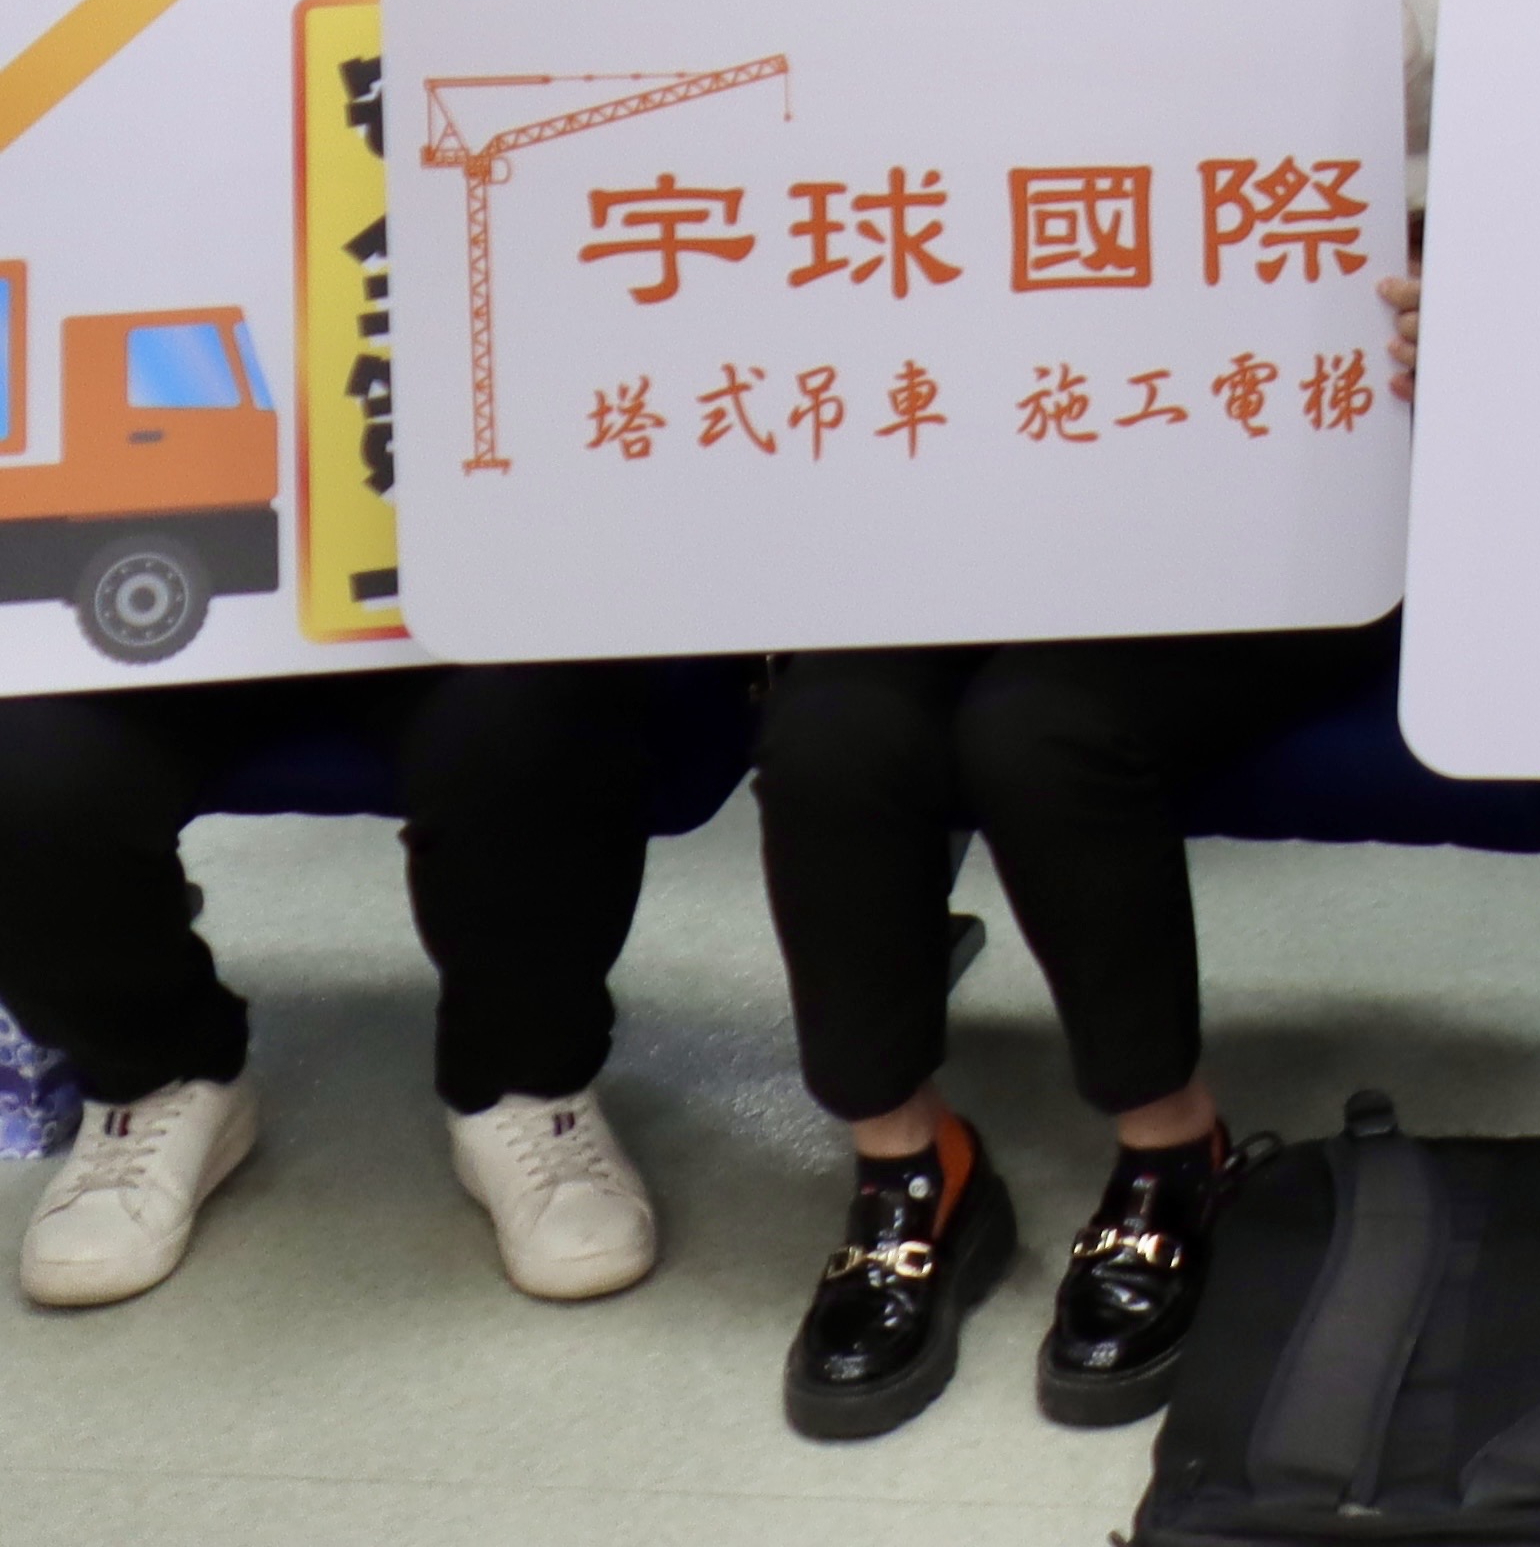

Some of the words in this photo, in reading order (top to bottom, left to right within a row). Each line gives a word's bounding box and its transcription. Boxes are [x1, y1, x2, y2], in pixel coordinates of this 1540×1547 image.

[579, 155, 1370, 304] 宇球國際
[585, 361, 949, 460] 塔式吊車
[1016, 350, 1374, 443] 施工電梯
